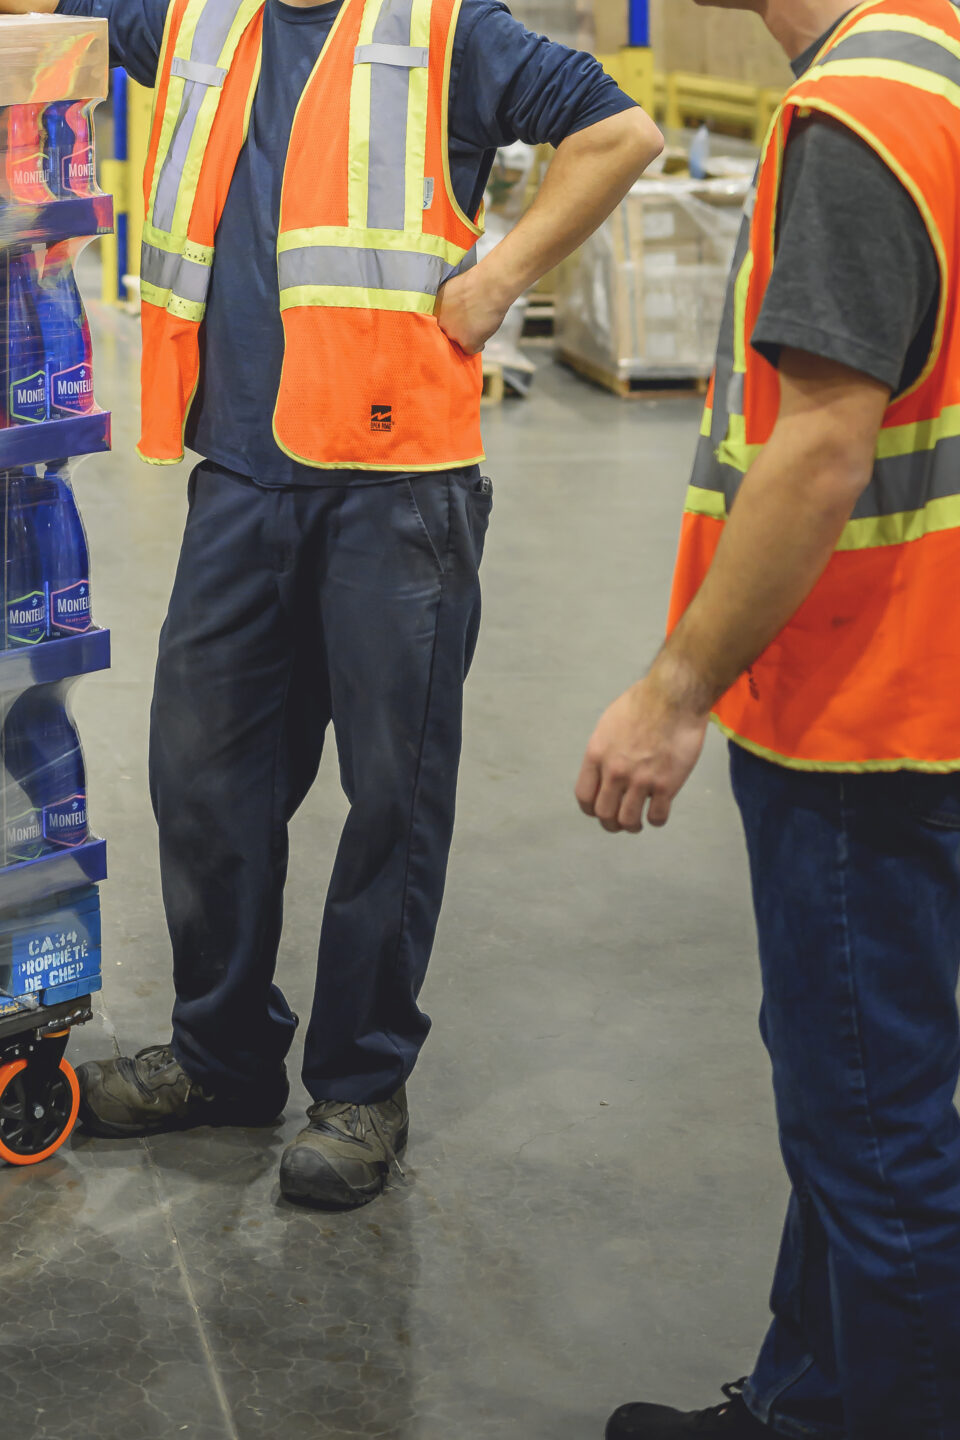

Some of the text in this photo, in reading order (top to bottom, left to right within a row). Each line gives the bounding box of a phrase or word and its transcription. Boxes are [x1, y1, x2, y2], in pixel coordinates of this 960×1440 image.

[19, 939, 88, 976] PROPRIÉTÉ
[24, 962, 83, 993] DE CHEP
